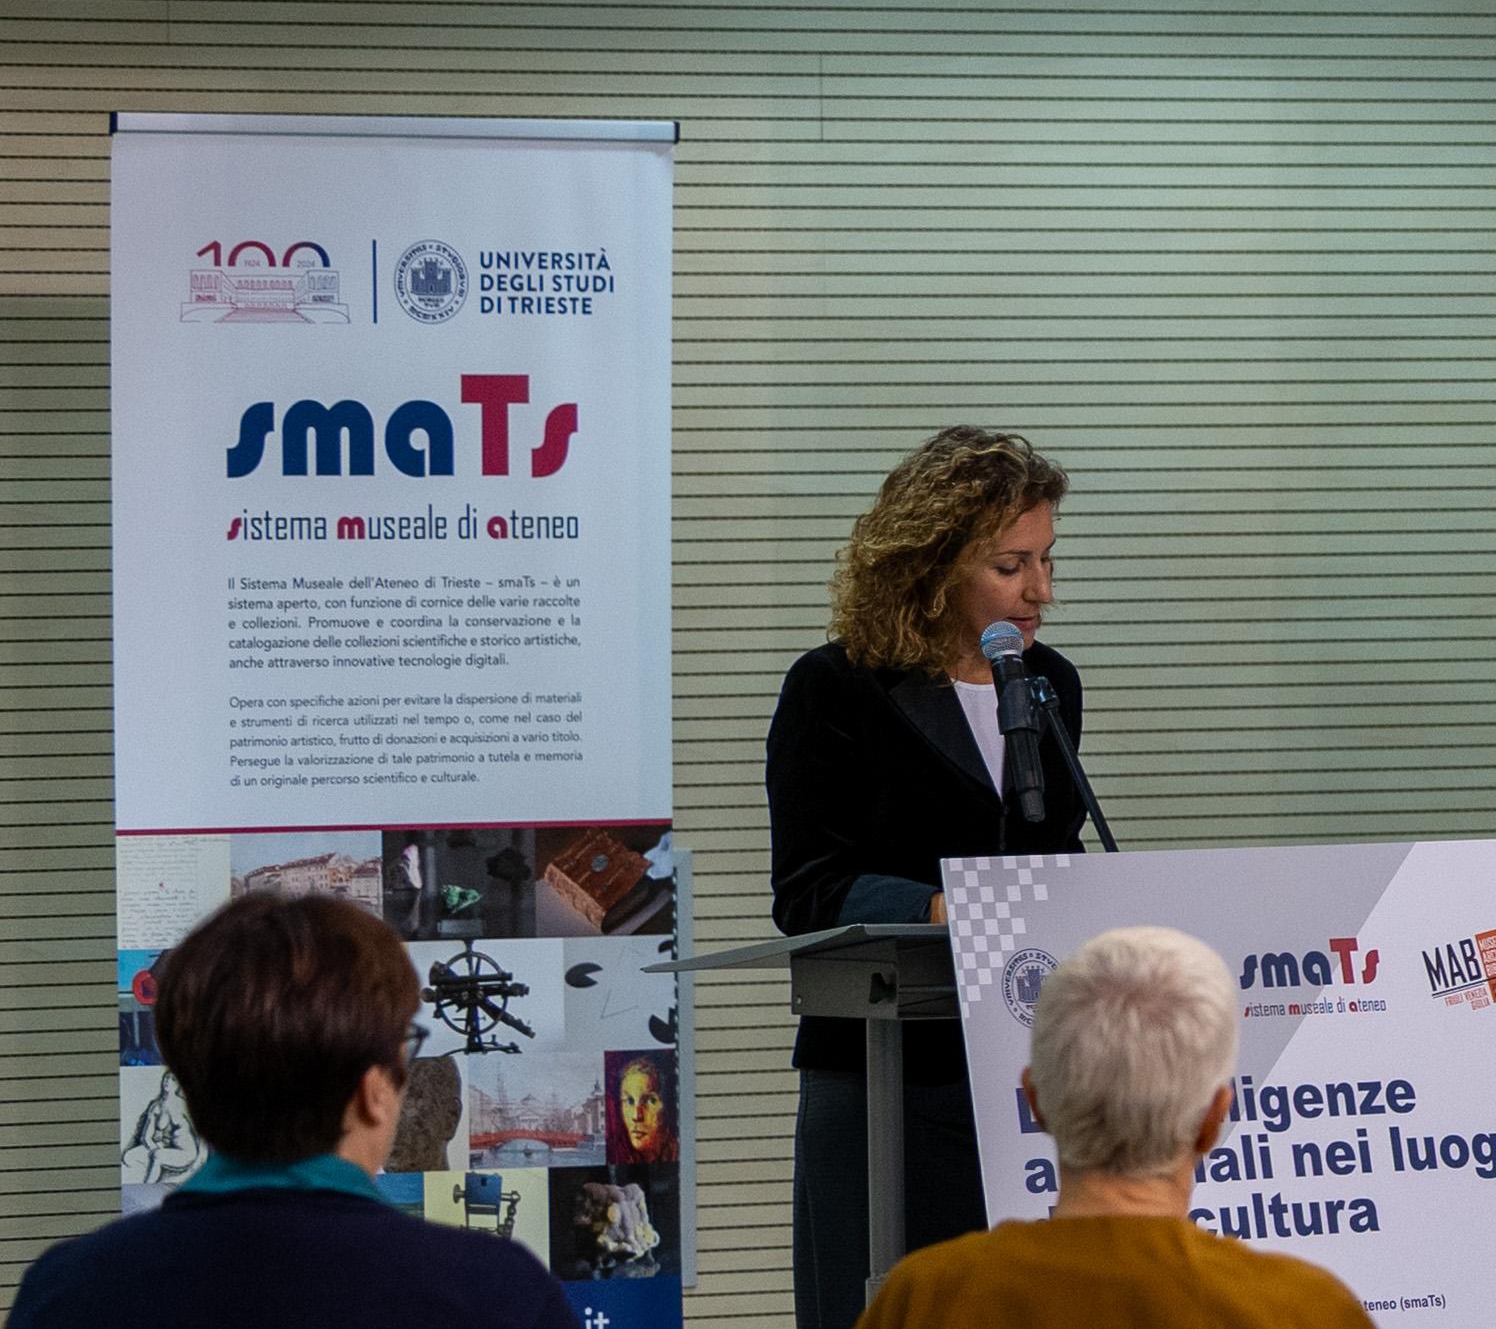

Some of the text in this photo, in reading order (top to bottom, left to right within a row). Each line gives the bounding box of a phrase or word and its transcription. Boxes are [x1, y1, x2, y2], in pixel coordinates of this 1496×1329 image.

[480, 247, 610, 270] UNIVERSITÀ
[481, 274, 614, 292] DEGLI STUDI
[481, 296, 592, 314] DI TRIESTE
[227, 374, 578, 478] smaTs
[227, 503, 578, 540] sistema museale di ateneo
[228, 578, 234, 589] Il
[240, 578, 287, 589] Sistema
[292, 578, 343, 589] Museale
[424, 577, 435, 588] di
[441, 577, 481, 588] Trieste
[498, 576, 535, 588] smaTs
[553, 575, 561, 587] è
[567, 579, 580, 587] un
[228, 595, 580, 613] sistema aperto, con funzione di cornice delle varie raccolte
[228, 621, 235, 629] e
[242, 617, 301, 629] collezioni.
[309, 617, 370, 628] Promuove
[390, 616, 442, 628] coordina
[449, 615, 459, 627] la
[465, 615, 551, 627] conservazione
[571, 614, 580, 626] la
[229, 633, 581, 651] catalogazione delle collezioni scientifiche e storico artistiche,
[229, 654, 509, 669] anche attraverso innovative tecnologie digitali.
[230, 692, 582, 710] Opera con specifiche azioni per evitare la dispersione di materiali
[230, 711, 582, 727] e strumenti di ricerca utilizzati nel tempo o, come nel caso del
[230, 735, 288, 750] patrimonio
[291, 736, 336, 747] artistico,
[339, 734, 369, 745] frutto
[373, 734, 383, 744] di
[386, 733, 437, 744] donazioni
[450, 732, 510, 745] acquisizioni
[513, 734, 519, 742] a
[522, 732, 548, 742] vario
[553, 730, 581, 742] titolo.
[230, 756, 280, 769] Persegue
[285, 755, 293, 766] la
[297, 754, 373, 765] valorizzazione
[378, 753, 388, 764] di
[393, 753, 412, 764] tale
[416, 753, 474, 766] patrimonio
[489, 751, 519, 762] tutela
[524, 753, 530, 761] e
[535, 750, 582, 761] memoria
[230, 771, 480, 788] di un originale percorso scientifico e culturale.
[1240, 937, 1380, 989] smaTs
[1422, 939, 1482, 991] MAB
[1244, 997, 1386, 1017] sistema museale di ateneo
[1230, 1077, 1416, 1132] ligenze
[1292, 1129, 1373, 1177] nei
[1190, 1193, 1380, 1239] cultura
[1363, 1294, 1445, 1311] teneo (smaTs)
